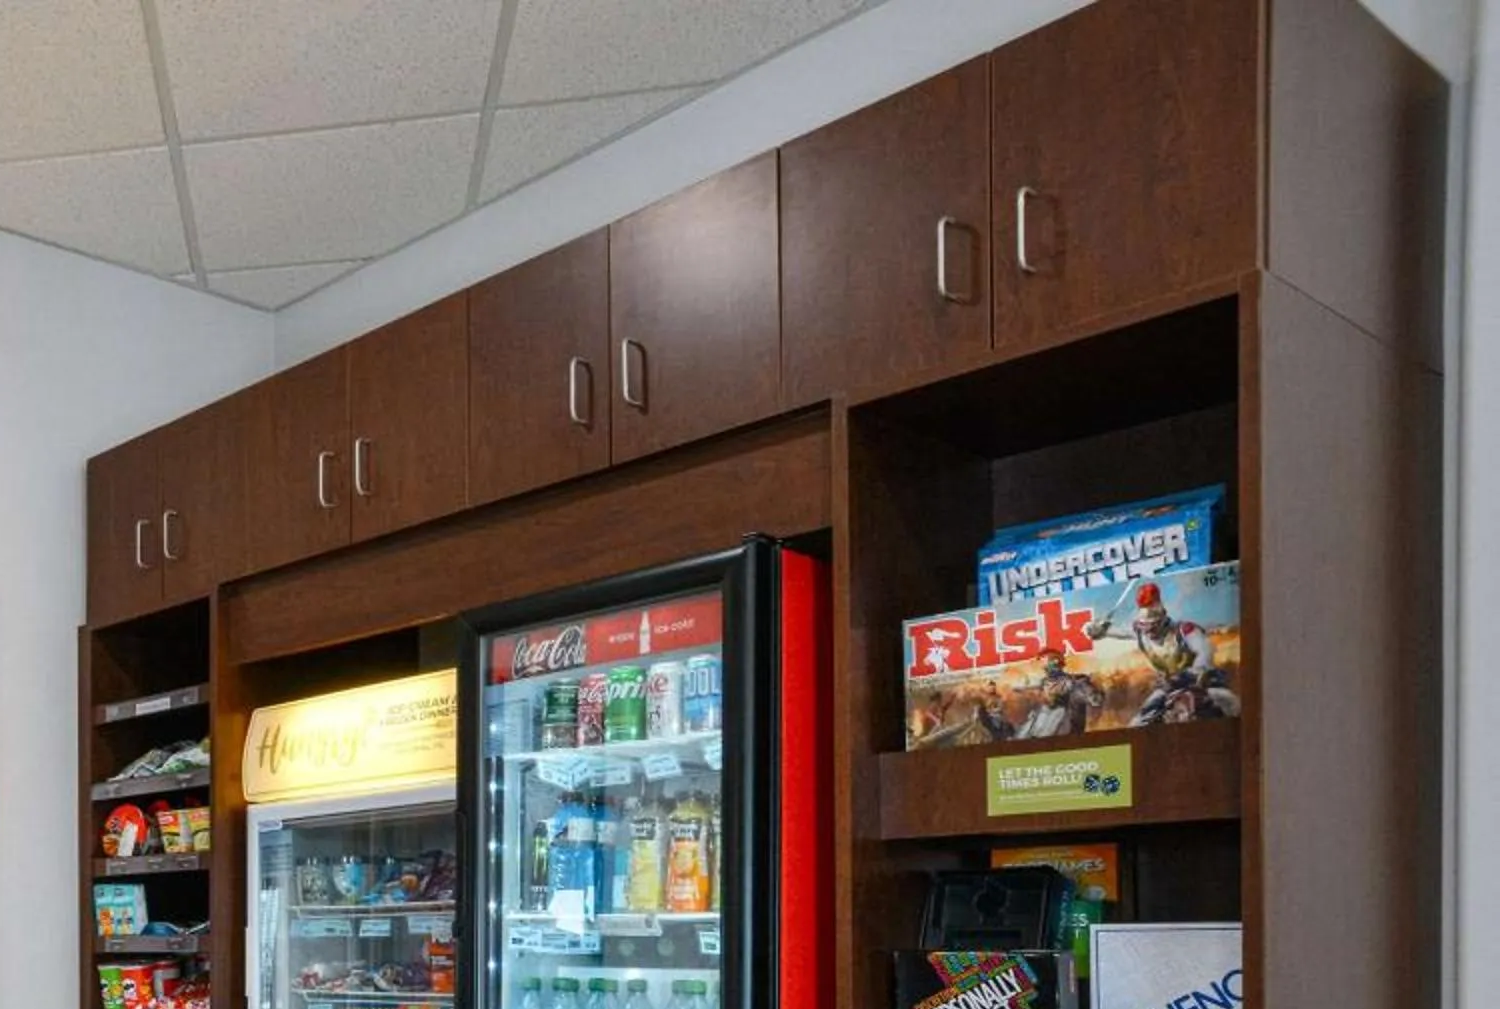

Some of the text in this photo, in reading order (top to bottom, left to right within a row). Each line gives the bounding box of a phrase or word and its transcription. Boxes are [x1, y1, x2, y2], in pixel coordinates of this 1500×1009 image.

[989, 524, 1189, 603] UNDERCOVER
[512, 625, 587, 679] Coca-Cola
[908, 598, 1094, 679] Risk
[999, 761, 1100, 779] LET THE GOOD
[999, 777, 1039, 790] TIMES
